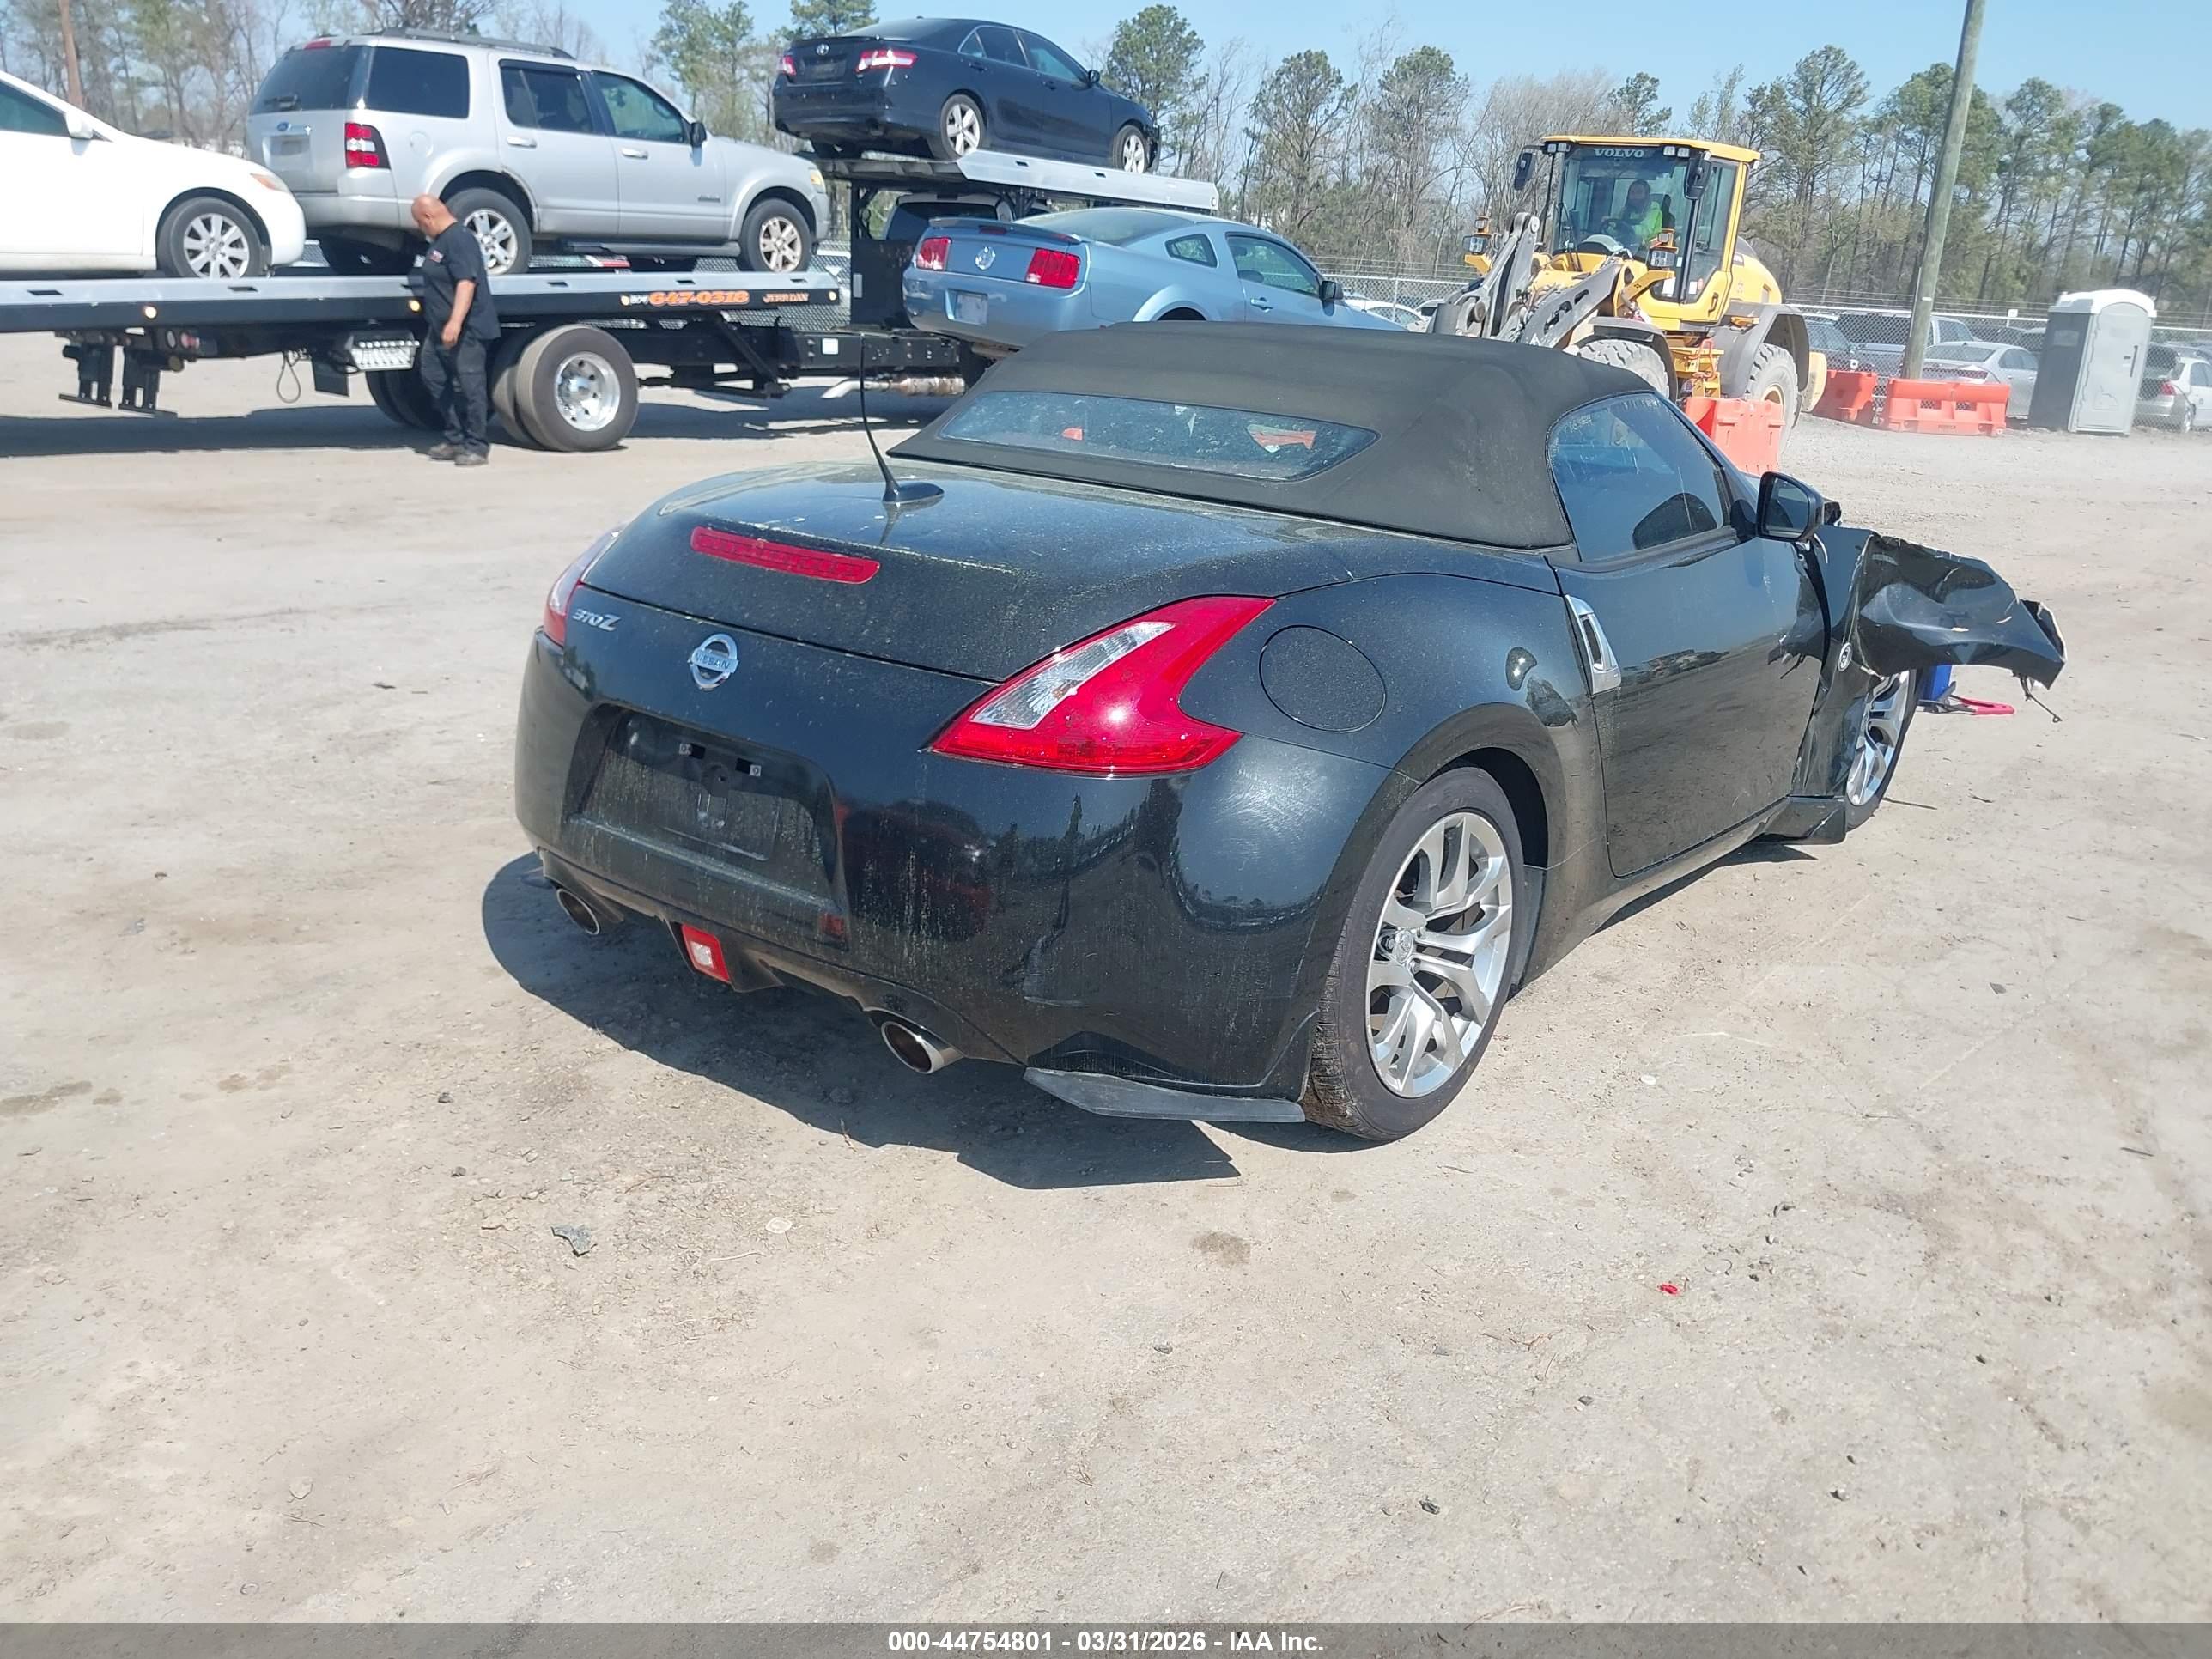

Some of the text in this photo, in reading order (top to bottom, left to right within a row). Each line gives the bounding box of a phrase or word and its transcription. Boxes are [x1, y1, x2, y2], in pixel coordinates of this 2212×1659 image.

[1593, 148, 1644, 158] VOLVO
[572, 608, 622, 631] 370Z
[695, 652, 731, 670] NISSAN
